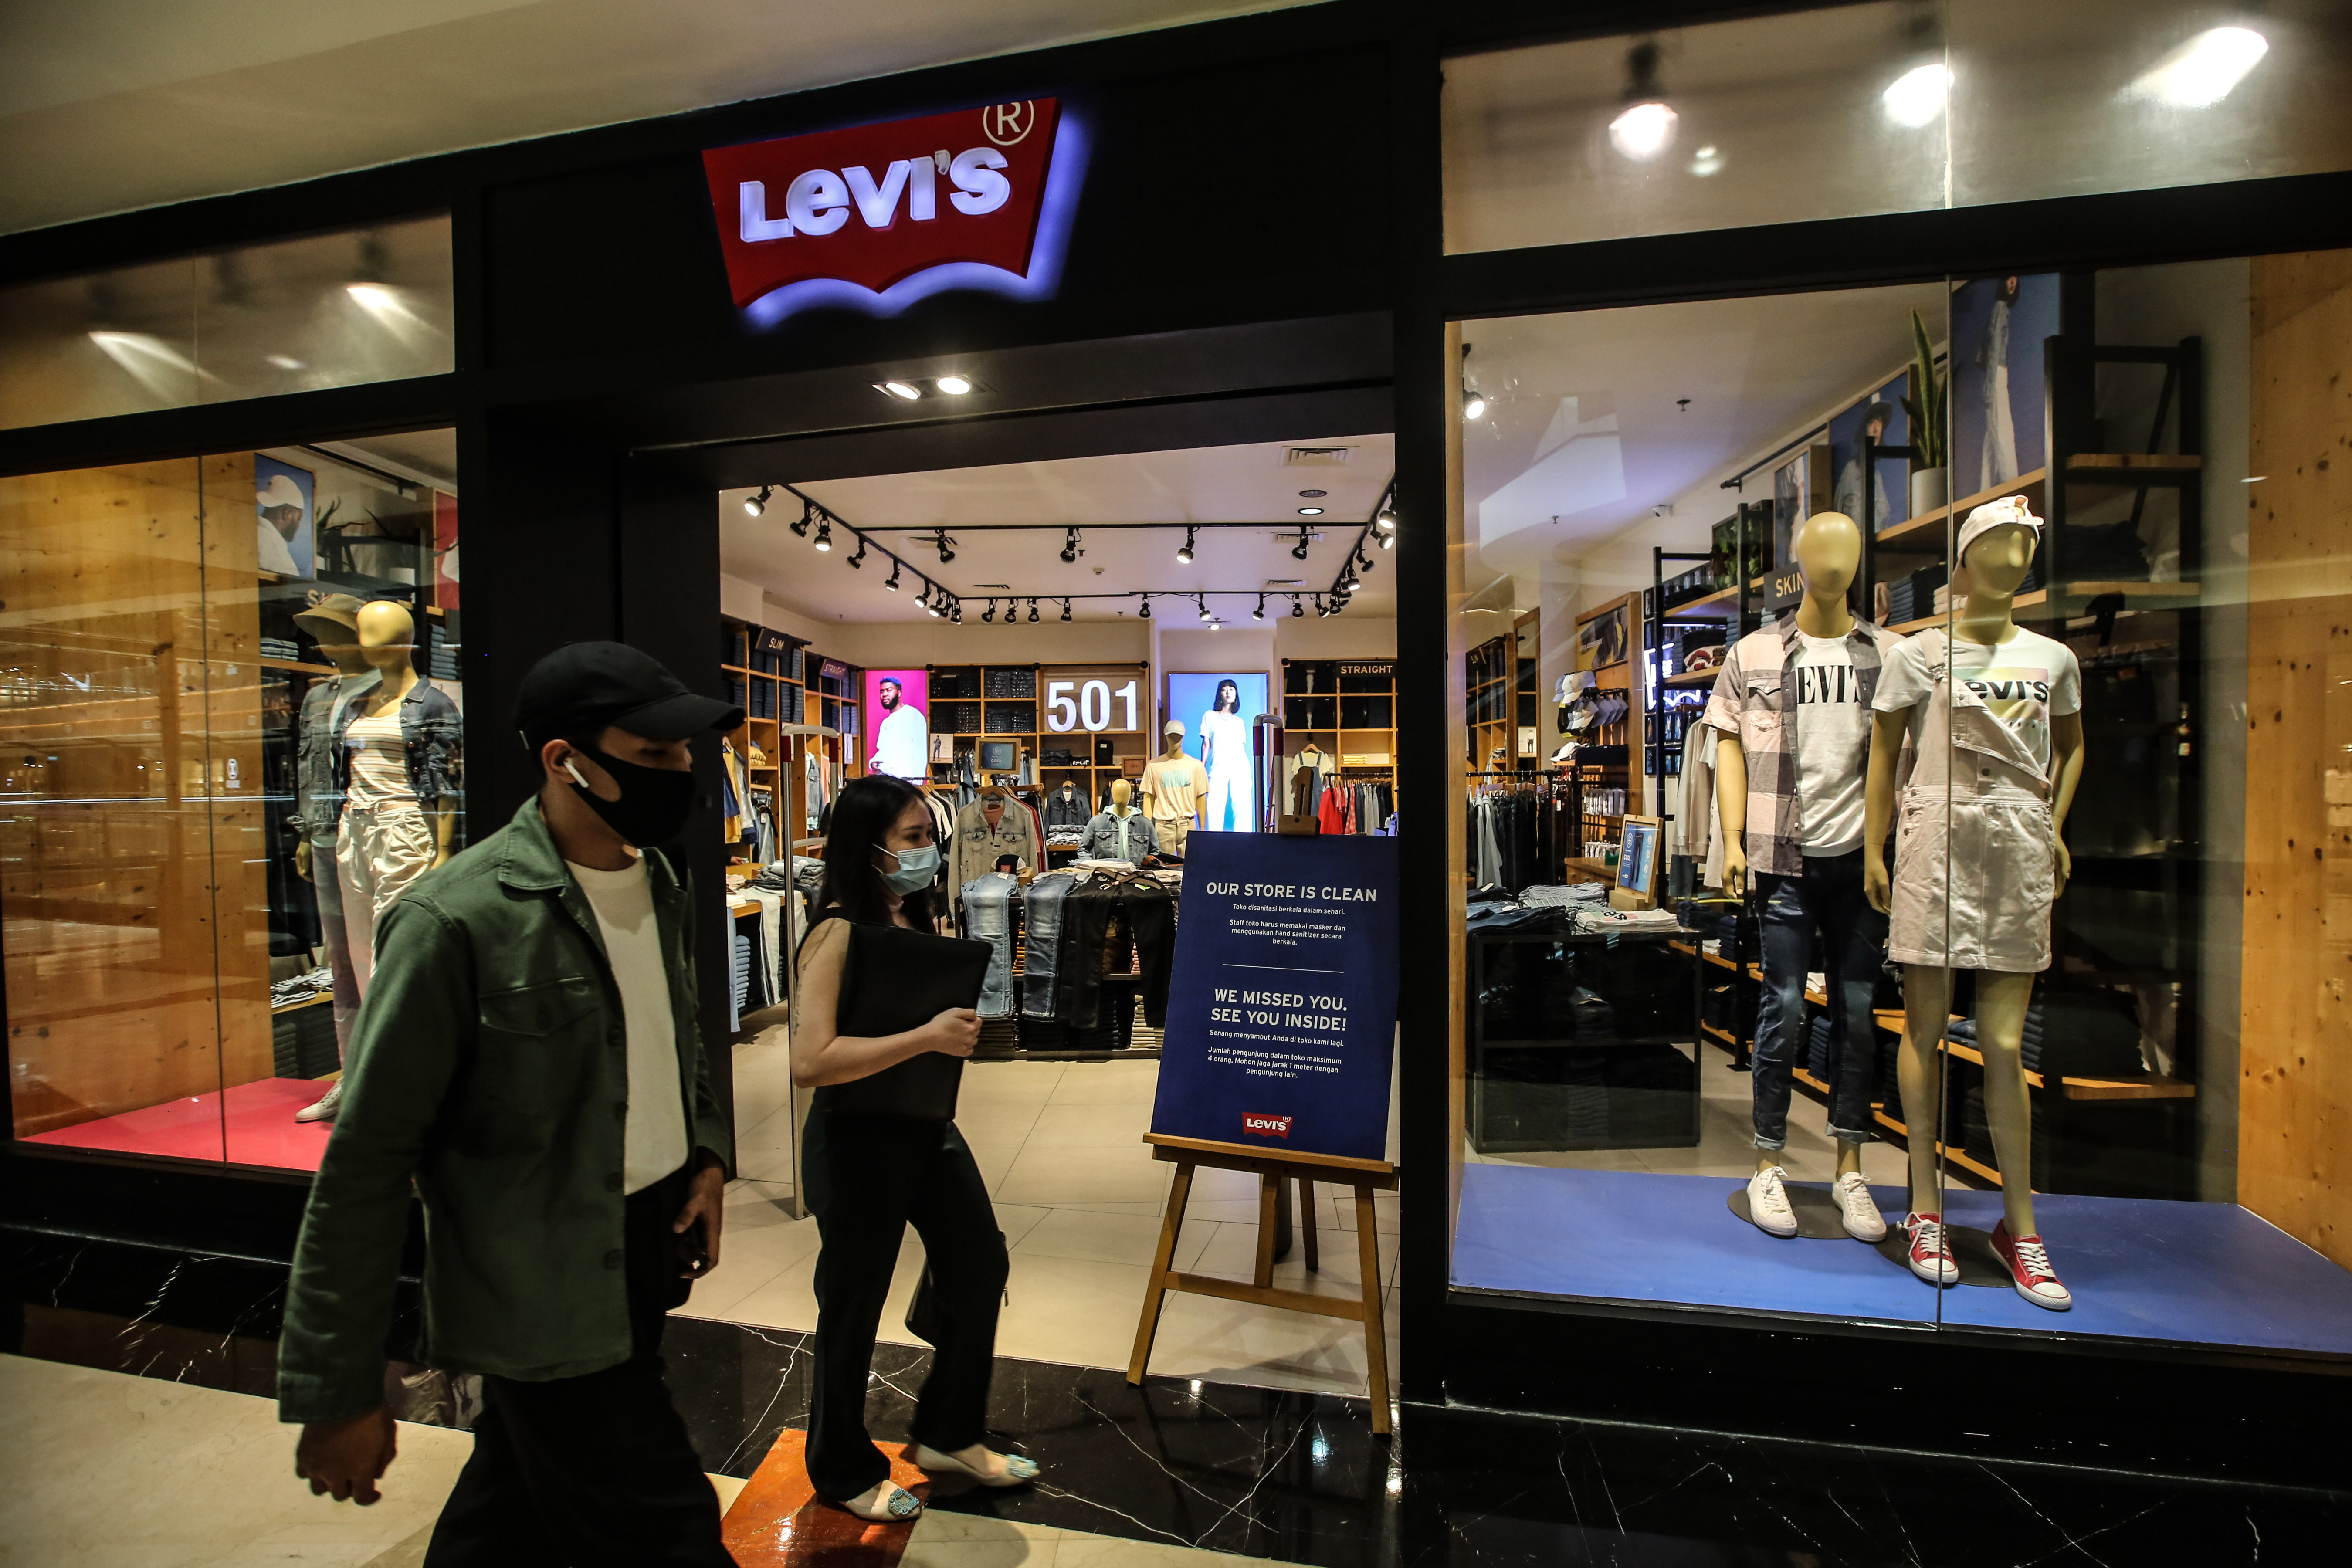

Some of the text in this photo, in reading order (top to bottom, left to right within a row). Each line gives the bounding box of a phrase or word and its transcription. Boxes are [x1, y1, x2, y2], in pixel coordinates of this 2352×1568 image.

[769, 637, 784, 650] SLIM
[824, 663, 845, 675] STRAIGHT
[1340, 665, 1393, 674] STRAIGHT
[1047, 679, 1137, 732] 501
[1207, 882, 1376, 902] OUR STORE IS CLEAN
[1215, 989, 1347, 1011] WE MISSED YOU.
[1211, 1008, 1346, 1031] SEE YOU INSIDE!
[1210, 1029, 1233, 1038] Senang
[1330, 1040, 1344, 1048] lagi.
[1232, 1050, 1269, 1059] pengunjung
[1307, 1056, 1342, 1064] maksimum
[1246, 1068, 1283, 1078] pengunjung
[1256, 1059, 1271, 1068] jaga
[1314, 1065, 1339, 1074] dengan
[1246, 1118, 1287, 1131] Levi's
